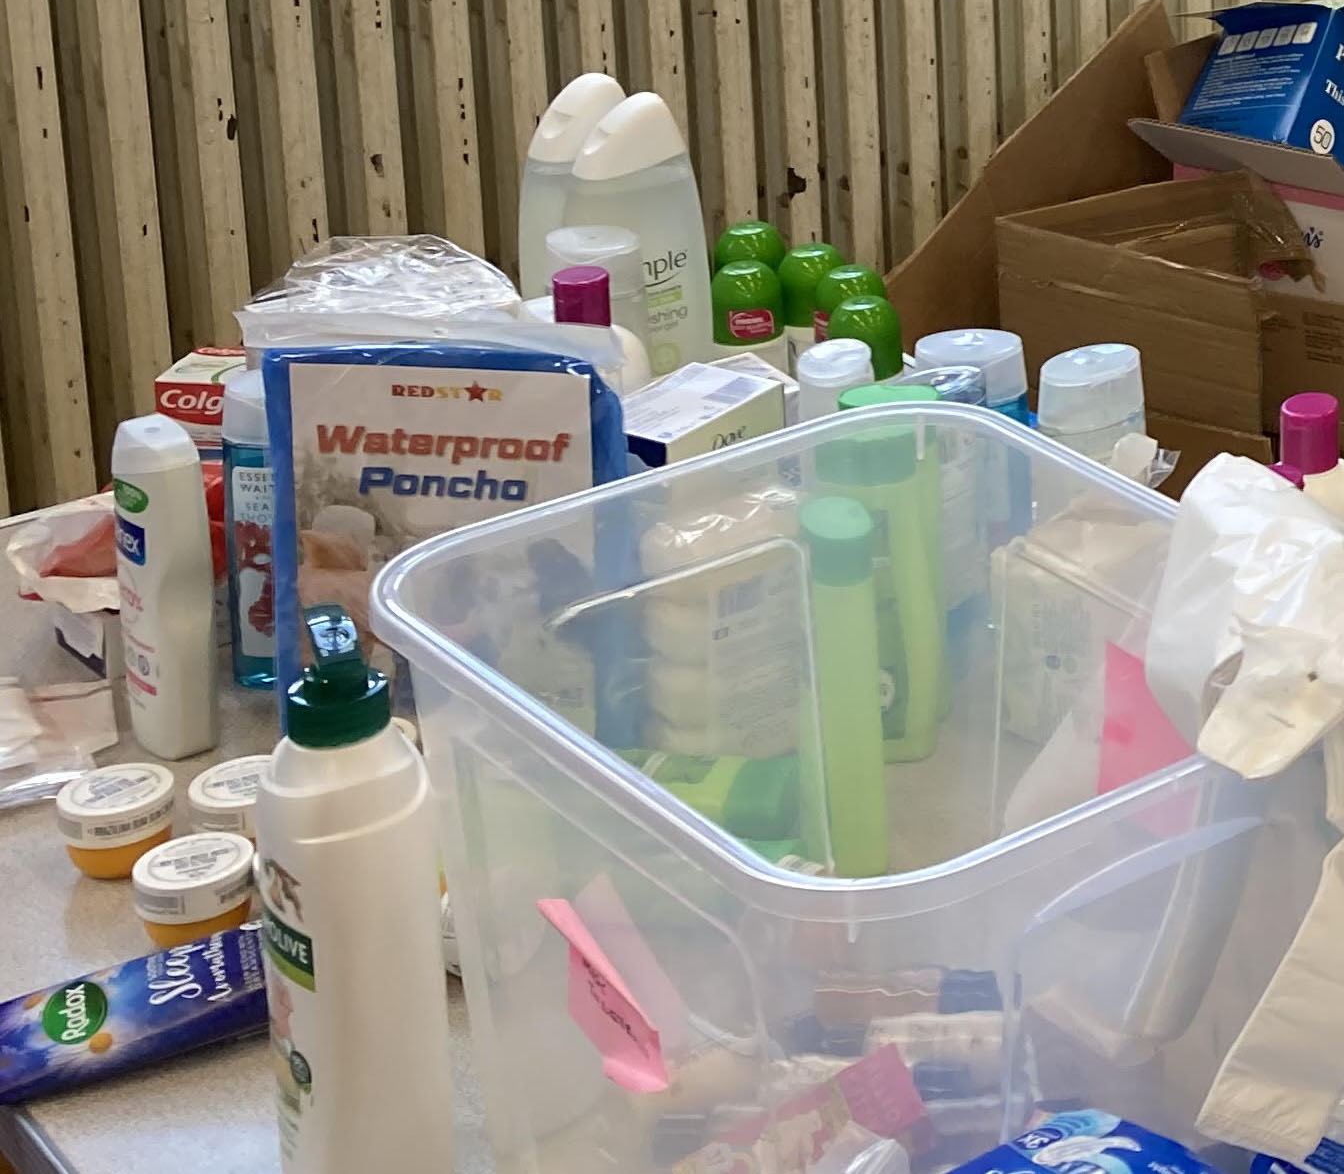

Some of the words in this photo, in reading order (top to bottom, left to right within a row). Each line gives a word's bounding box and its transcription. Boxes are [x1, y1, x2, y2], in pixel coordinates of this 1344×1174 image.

[1312, 125, 1332, 150] 50
[159, 388, 225, 415] Colg
[316, 424, 573, 465] Waterproof
[358, 466, 528, 502] Poncho
[149, 944, 205, 1005] Sleep
[61, 983, 87, 1042] Radox
